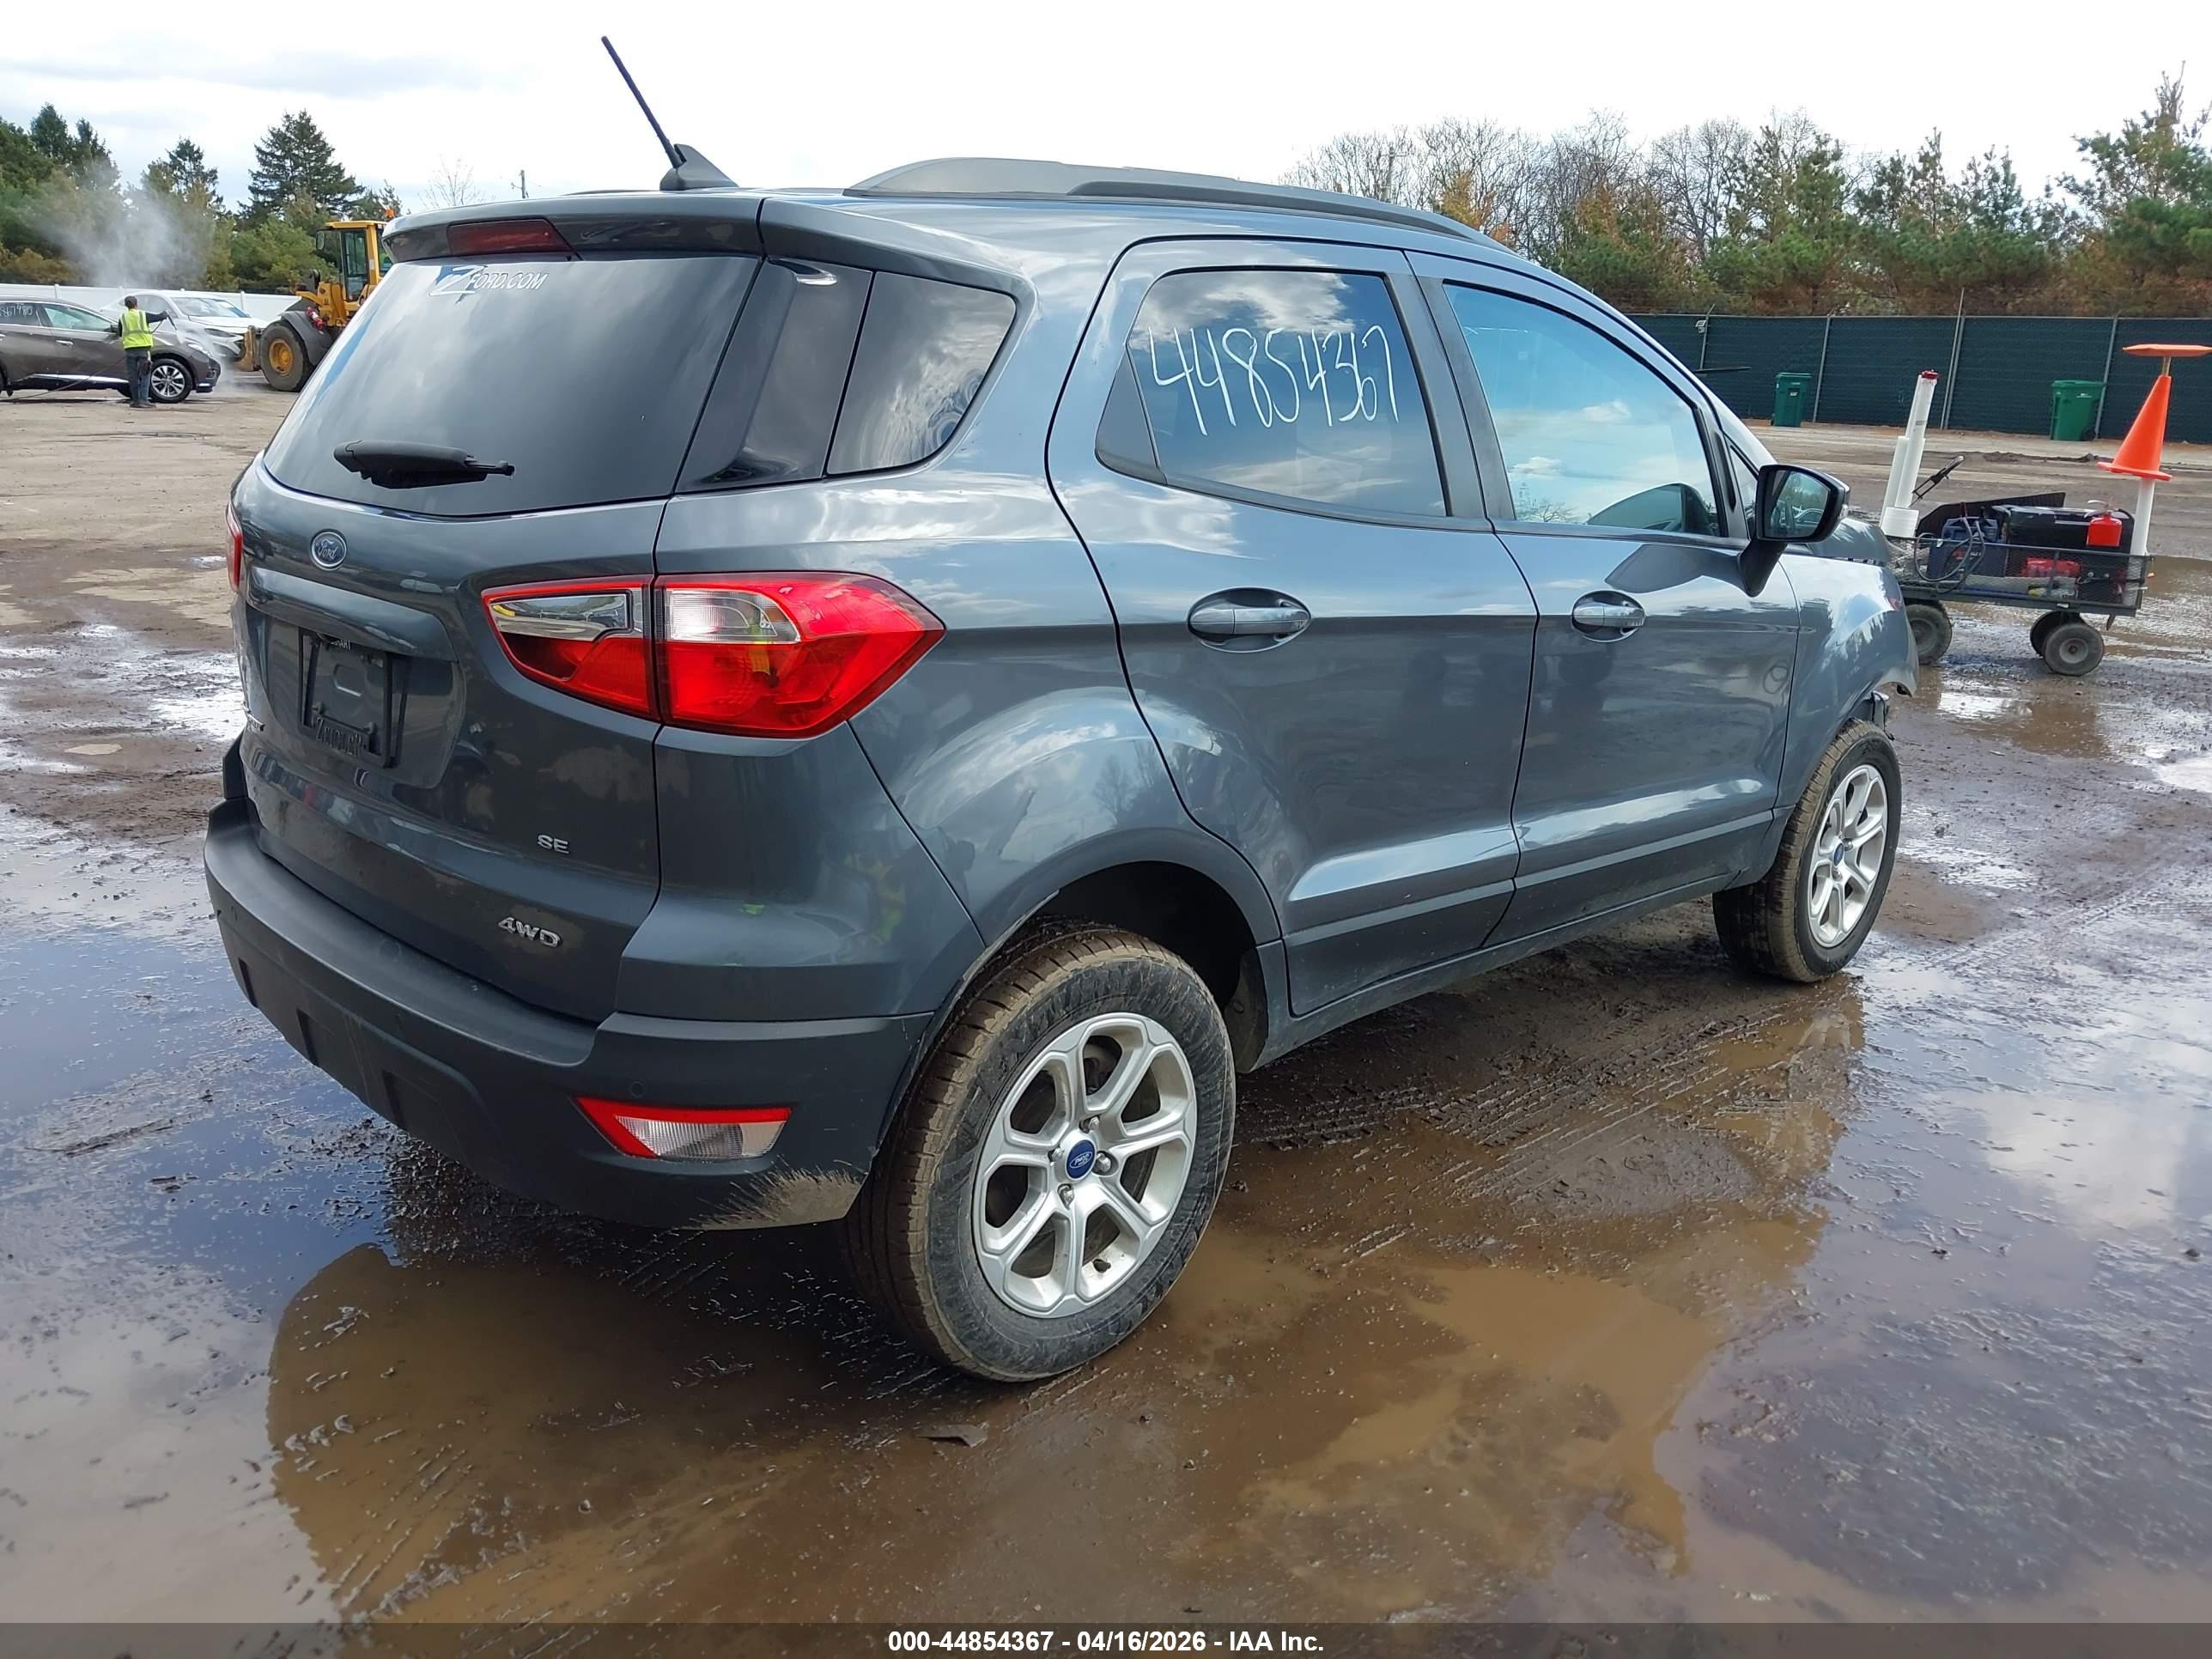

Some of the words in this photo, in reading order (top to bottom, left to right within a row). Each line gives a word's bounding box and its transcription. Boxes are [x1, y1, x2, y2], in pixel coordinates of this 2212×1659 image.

[1148, 325, 1400, 436] 44854367
[313, 536, 342, 562] Ford
[538, 834, 569, 854] SE
[498, 916, 561, 948] 4WD
